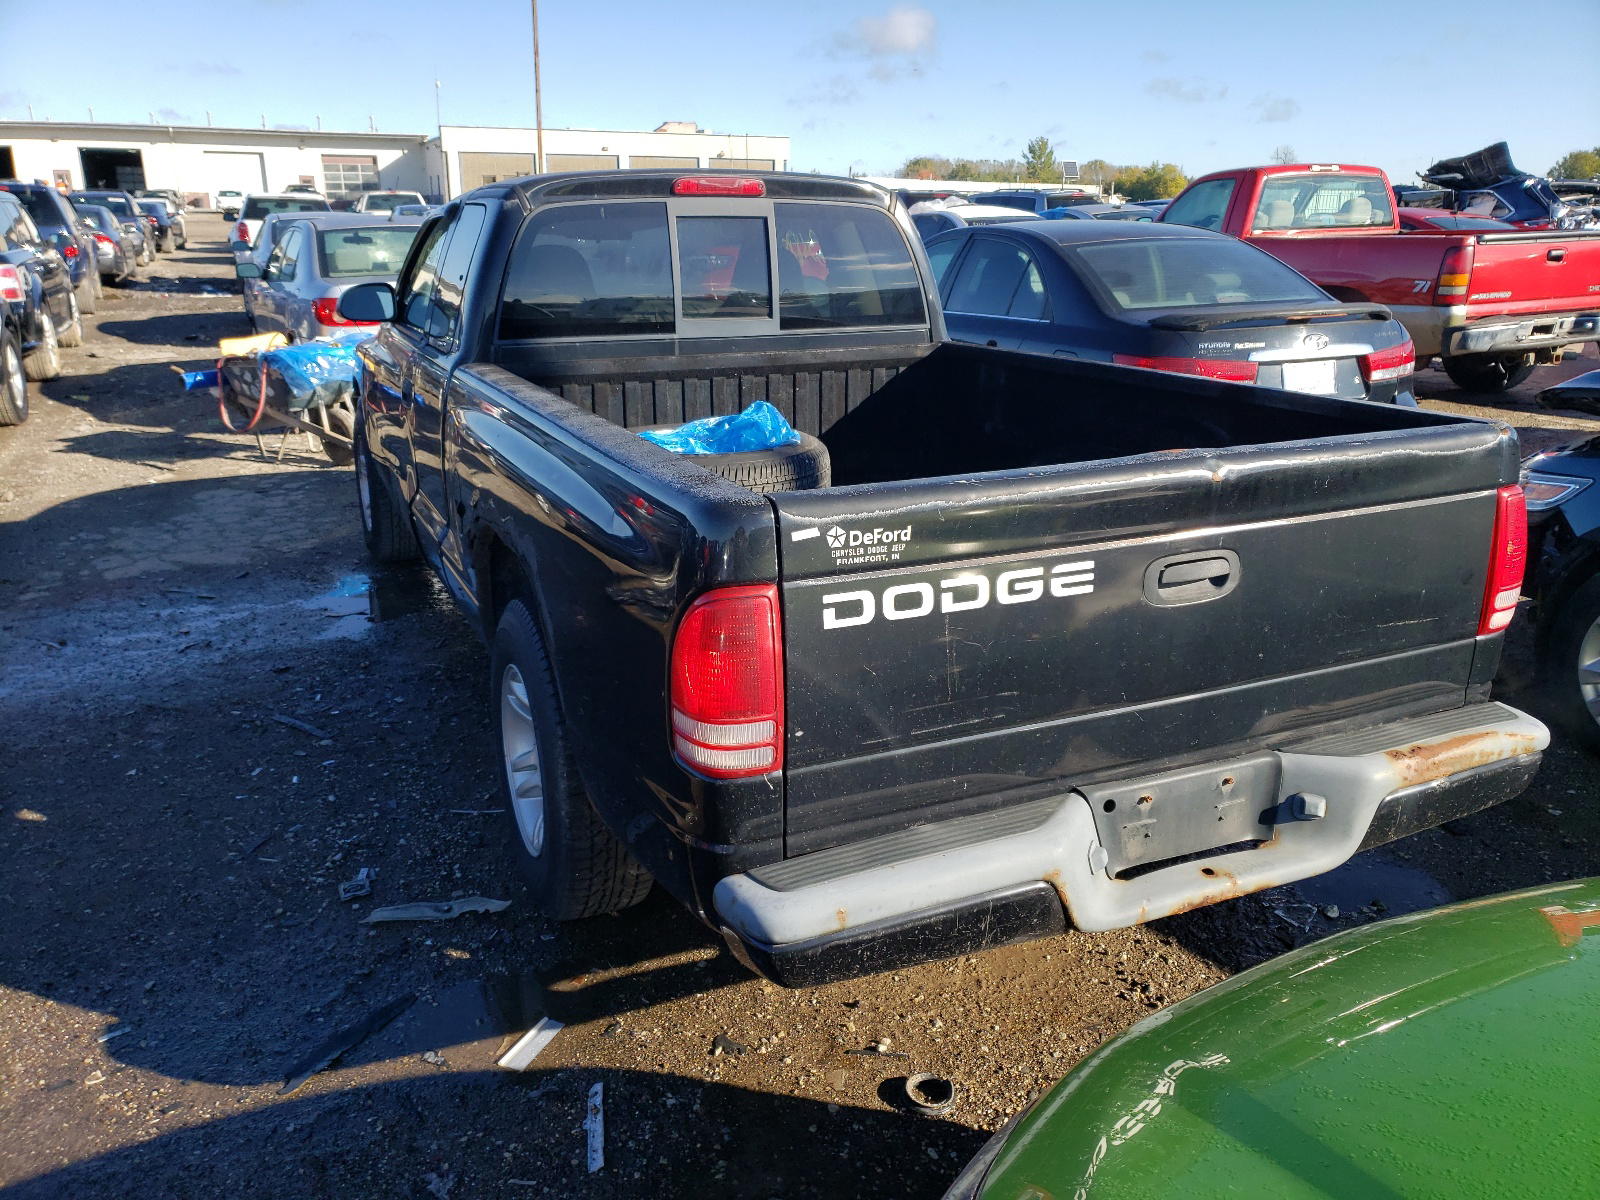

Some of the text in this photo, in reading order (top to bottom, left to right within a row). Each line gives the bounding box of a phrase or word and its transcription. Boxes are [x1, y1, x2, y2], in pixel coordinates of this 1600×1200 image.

[849, 525, 912, 547] DeFord
[831, 543, 906, 558] CHRYSLER DODGE JEEP
[836, 552, 900, 566] FRANKFORT, IN
[822, 560, 1095, 630] DODGE
